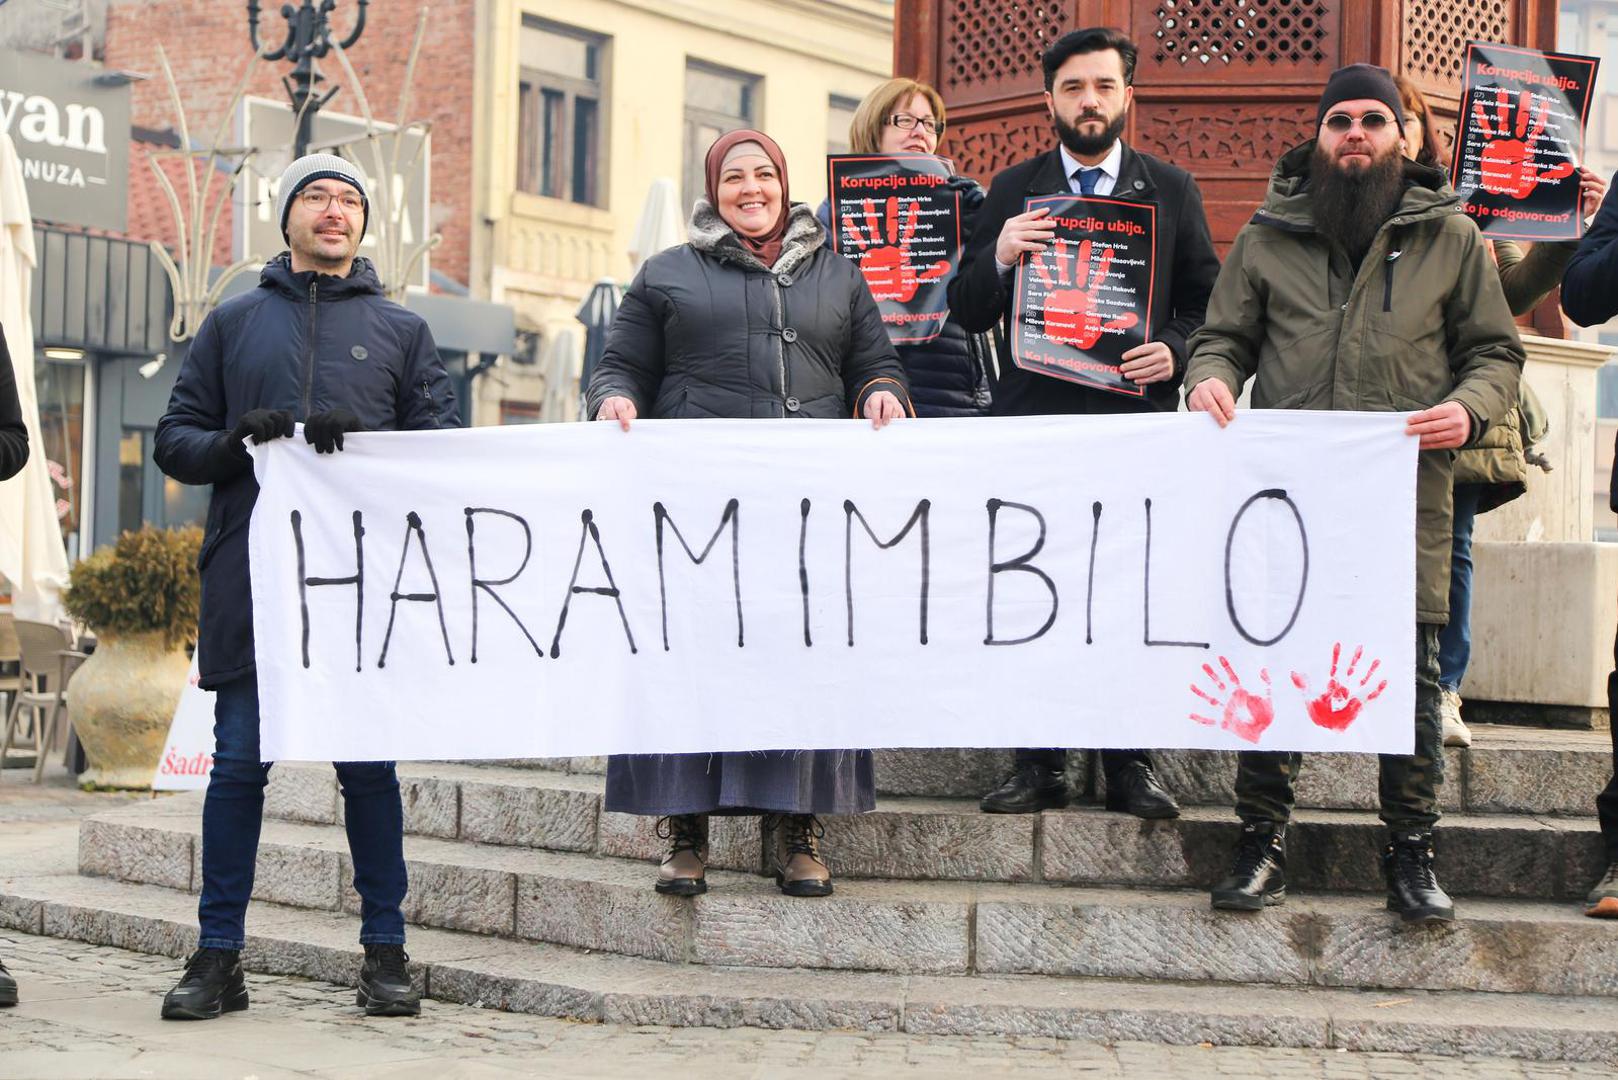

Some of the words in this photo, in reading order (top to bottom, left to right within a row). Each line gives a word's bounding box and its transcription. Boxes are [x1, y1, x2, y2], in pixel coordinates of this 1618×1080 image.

[1476, 63, 1541, 84] Korupcija
[841, 174, 907, 190] Korupcija
[1477, 204, 1489, 217] je
[1492, 207, 1570, 223] odgovoran?
[1108, 220, 1146, 236] ubija.
[1043, 353, 1056, 365] je
[291, 497, 745, 672] HARAM
[800, 496, 931, 647] IM
[984, 488, 1309, 649] BILO
